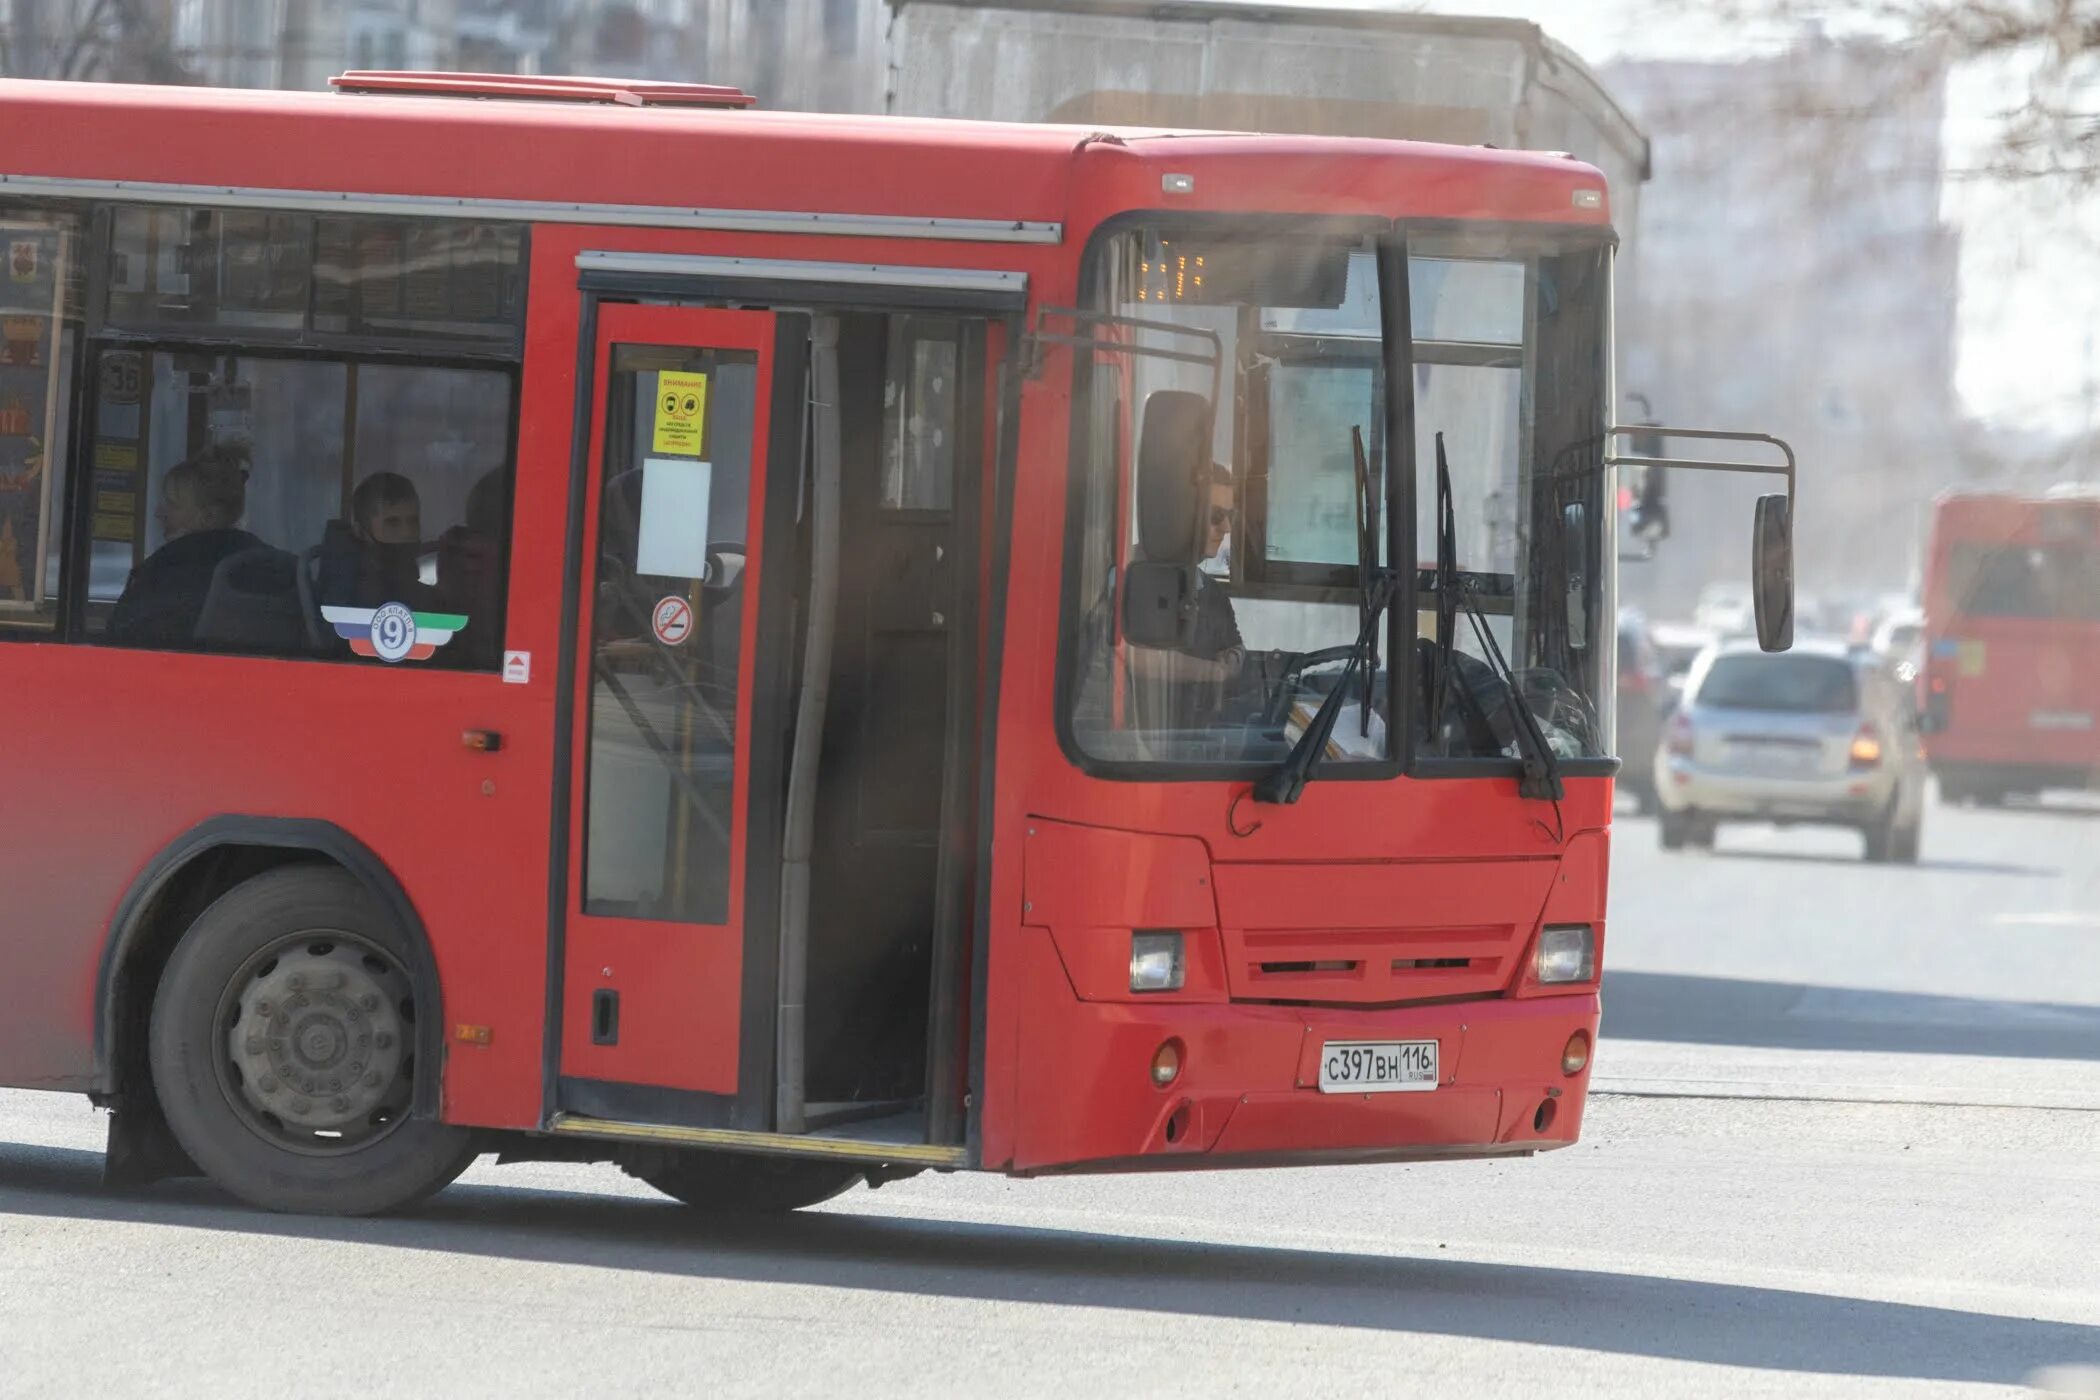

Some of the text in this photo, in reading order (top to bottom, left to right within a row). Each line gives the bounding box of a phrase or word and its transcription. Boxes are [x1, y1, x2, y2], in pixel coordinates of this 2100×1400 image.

[383, 615, 403, 648] 9
[1328, 1046, 1430, 1081] С397ВН 116
[1408, 1071, 1424, 1081] RUS
